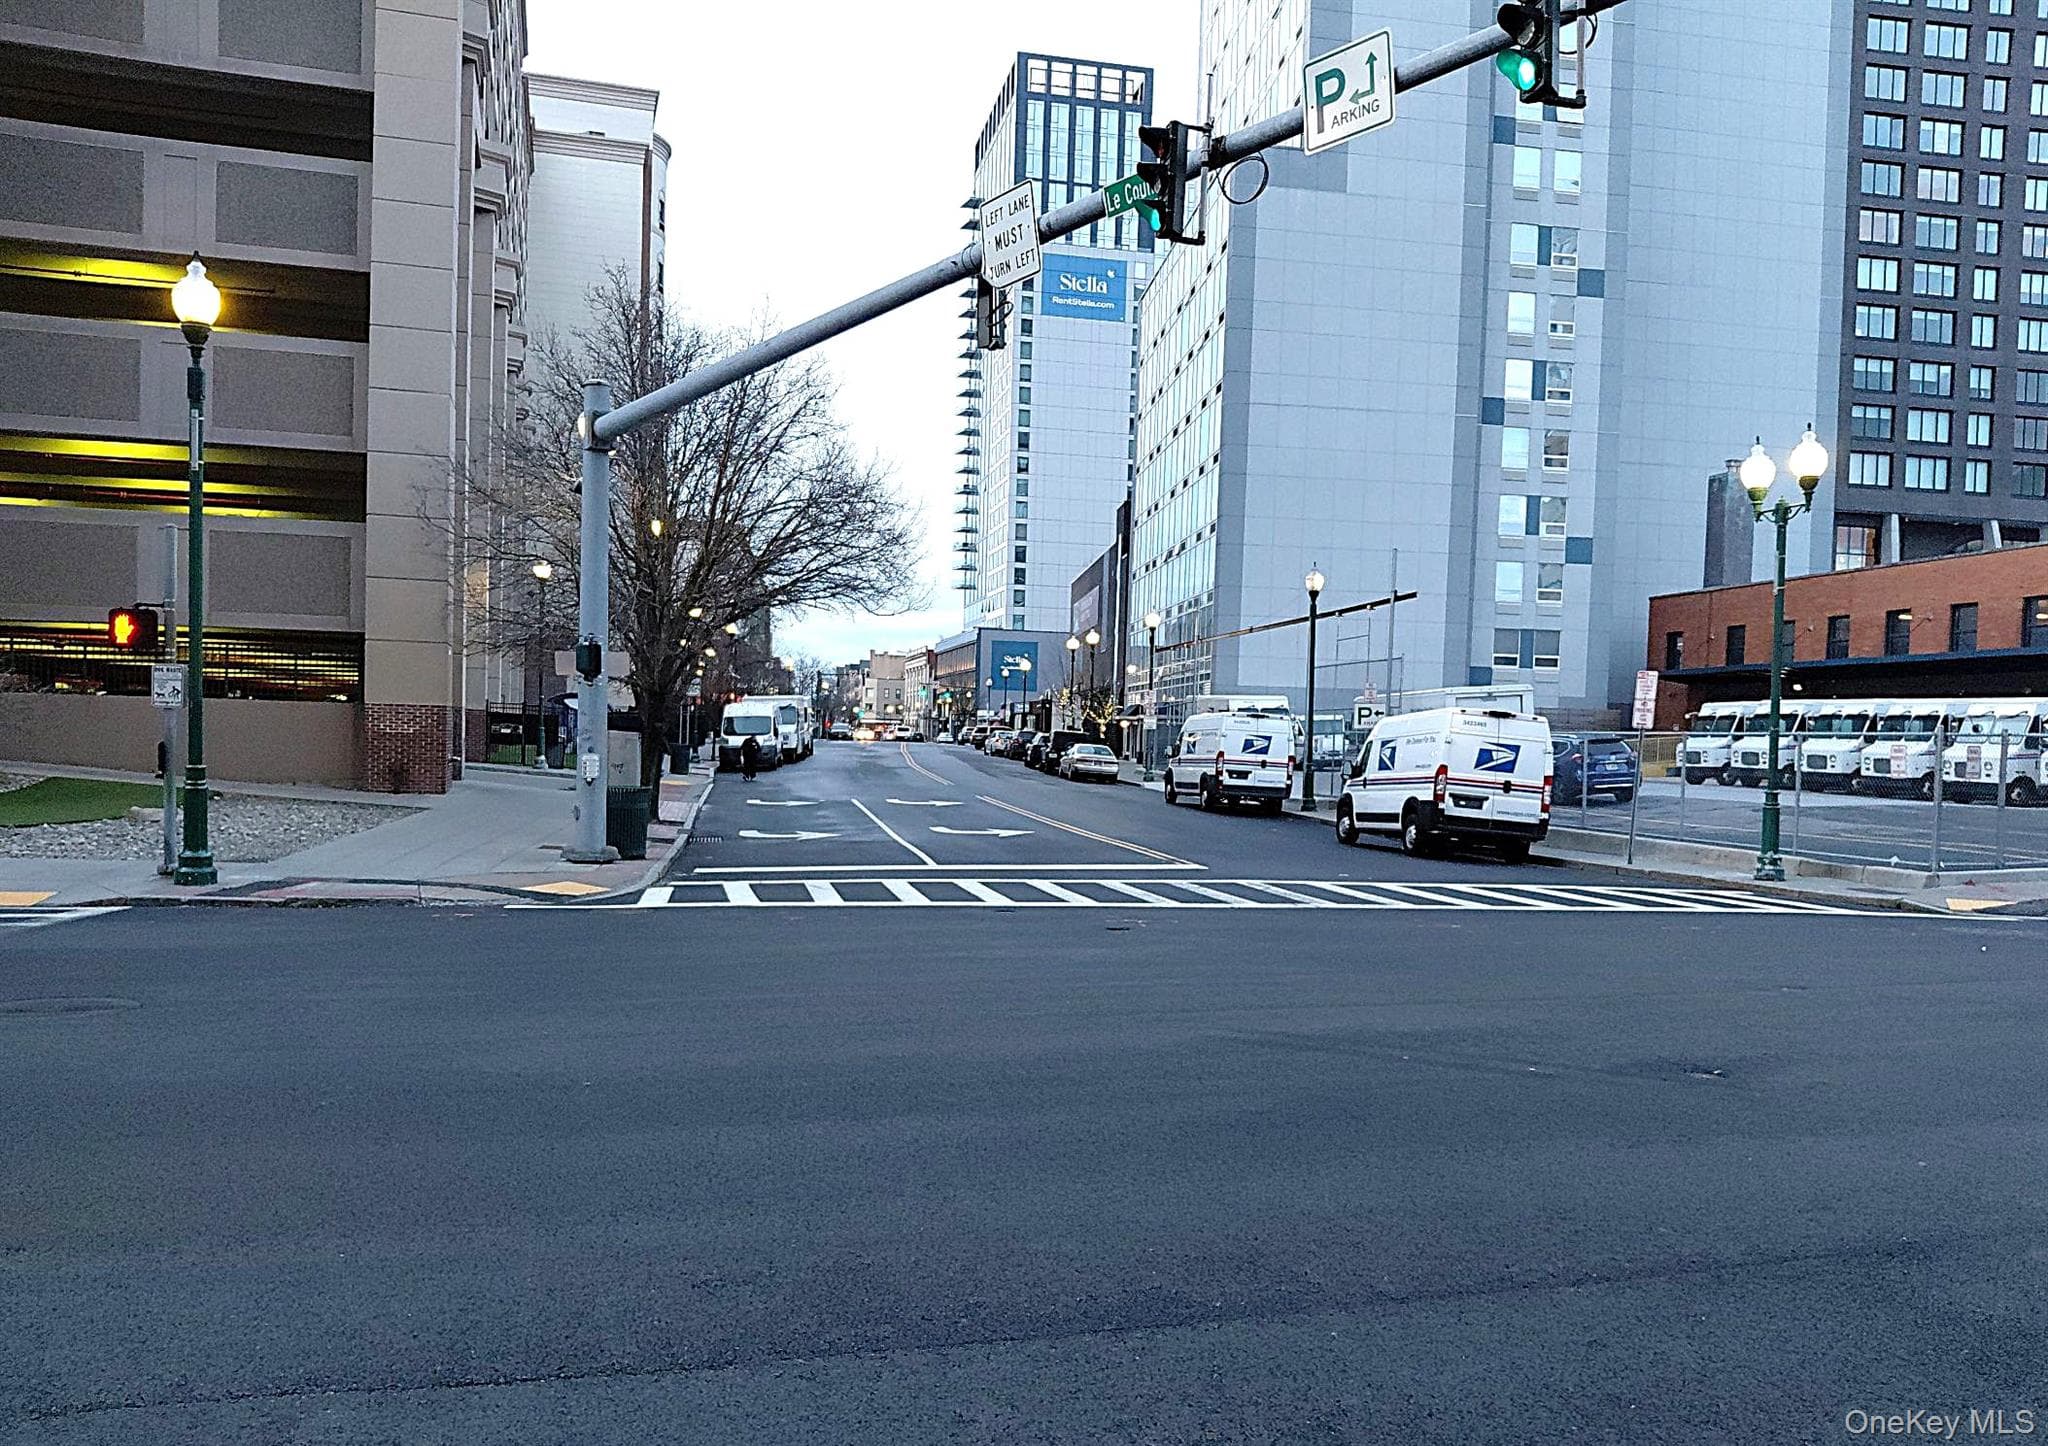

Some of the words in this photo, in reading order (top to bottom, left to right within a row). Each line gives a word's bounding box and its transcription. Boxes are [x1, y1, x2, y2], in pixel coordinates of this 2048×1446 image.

[985, 206, 1004, 228] LEFT
[1008, 194, 1030, 217] LANE
[1106, 191, 1121, 212] Le
[1124, 180, 1155, 204] Coun
[994, 223, 1023, 252] MUST
[990, 259, 1011, 280] TURN
[1016, 248, 1035, 269] LEFT
[1059, 273, 1108, 294] Stella
[1052, 296, 1115, 309] RentStella.com
